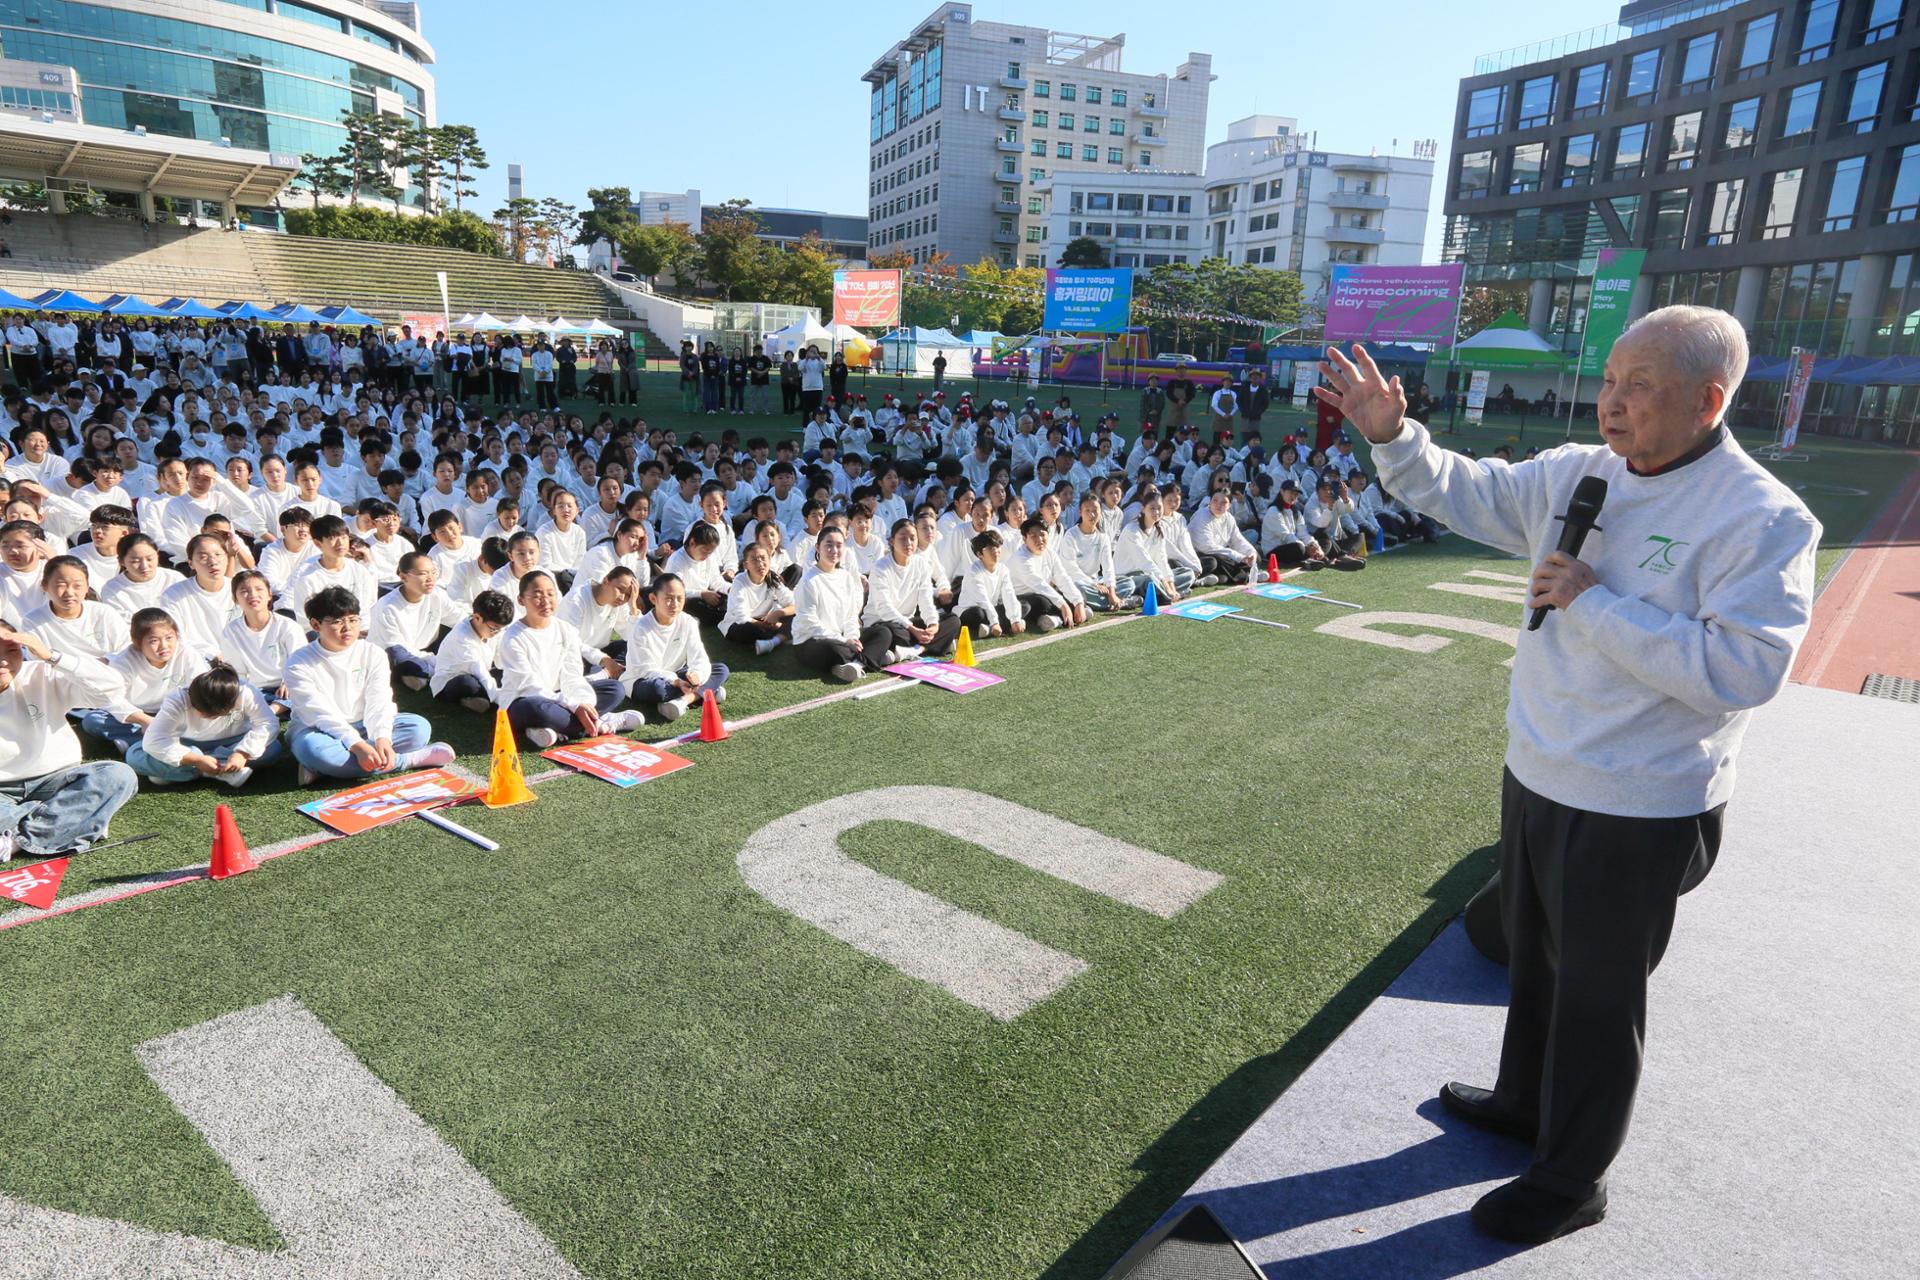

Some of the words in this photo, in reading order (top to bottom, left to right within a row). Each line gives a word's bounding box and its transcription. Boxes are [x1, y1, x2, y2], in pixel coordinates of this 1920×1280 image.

[42, 73, 60, 82] 409
[964, 84, 989, 112] IT
[1055, 287, 1114, 302] 홈커밍데이
[1336, 285, 1450, 299] Homecoming
[1335, 297, 1364, 309] day
